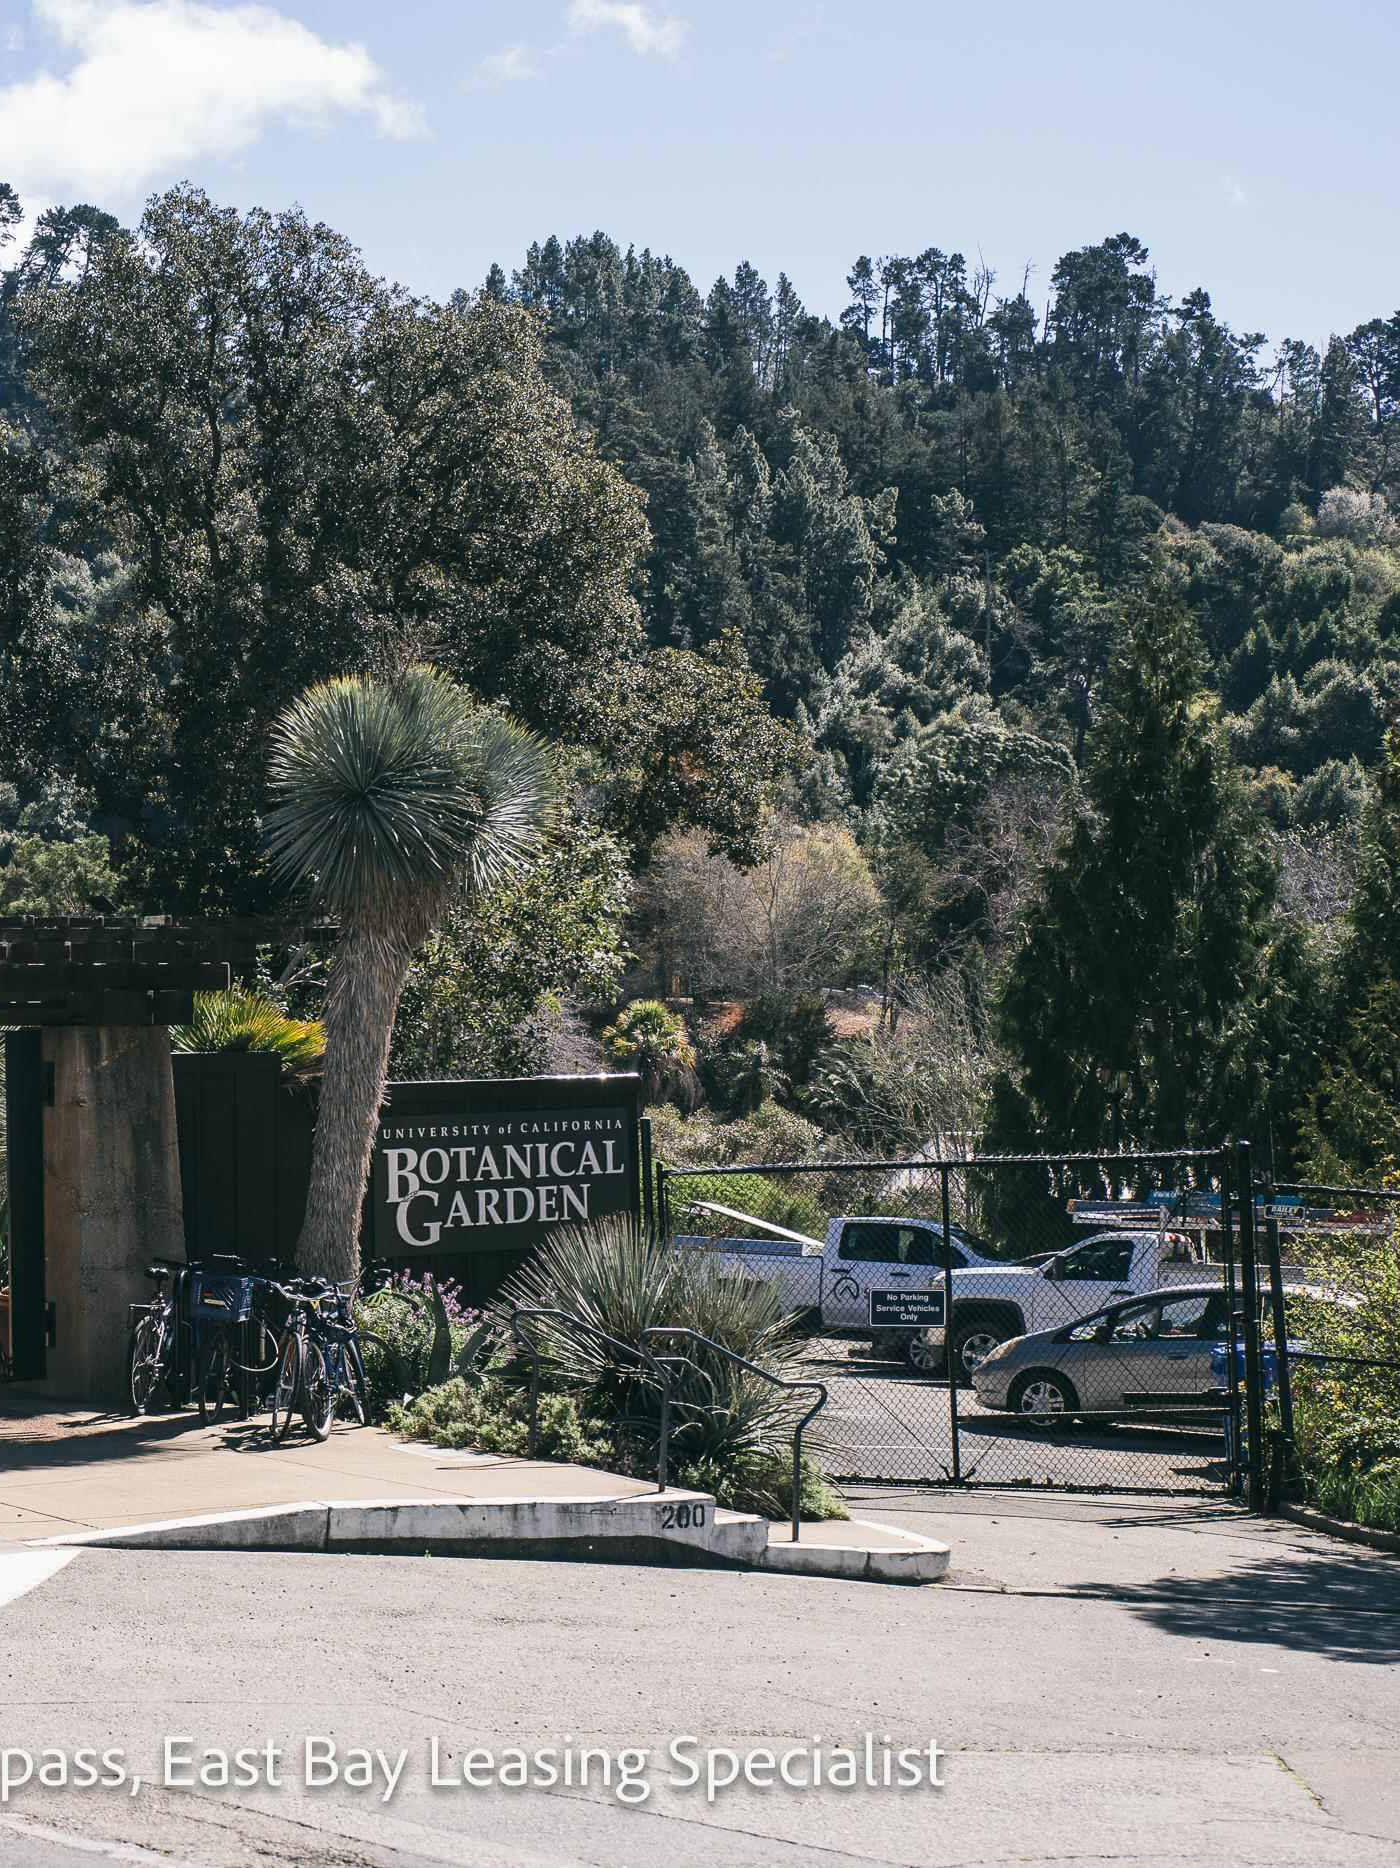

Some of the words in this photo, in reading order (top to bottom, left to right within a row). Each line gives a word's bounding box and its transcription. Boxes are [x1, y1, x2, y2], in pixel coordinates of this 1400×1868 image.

[383, 1124, 490, 1140] UNIVERSITY
[498, 1123, 513, 1135] of
[520, 1119, 622, 1133] CALIFORNIA
[382, 1140, 625, 1203] BOTANICAL
[395, 1183, 592, 1247] GARDEN
[876, 1304, 905, 1312] Service
[908, 1304, 940, 1312] Vehicles
[900, 1294, 929, 1303] Parking
[900, 1313, 918, 1321] Only
[662, 1503, 705, 1529] 200
